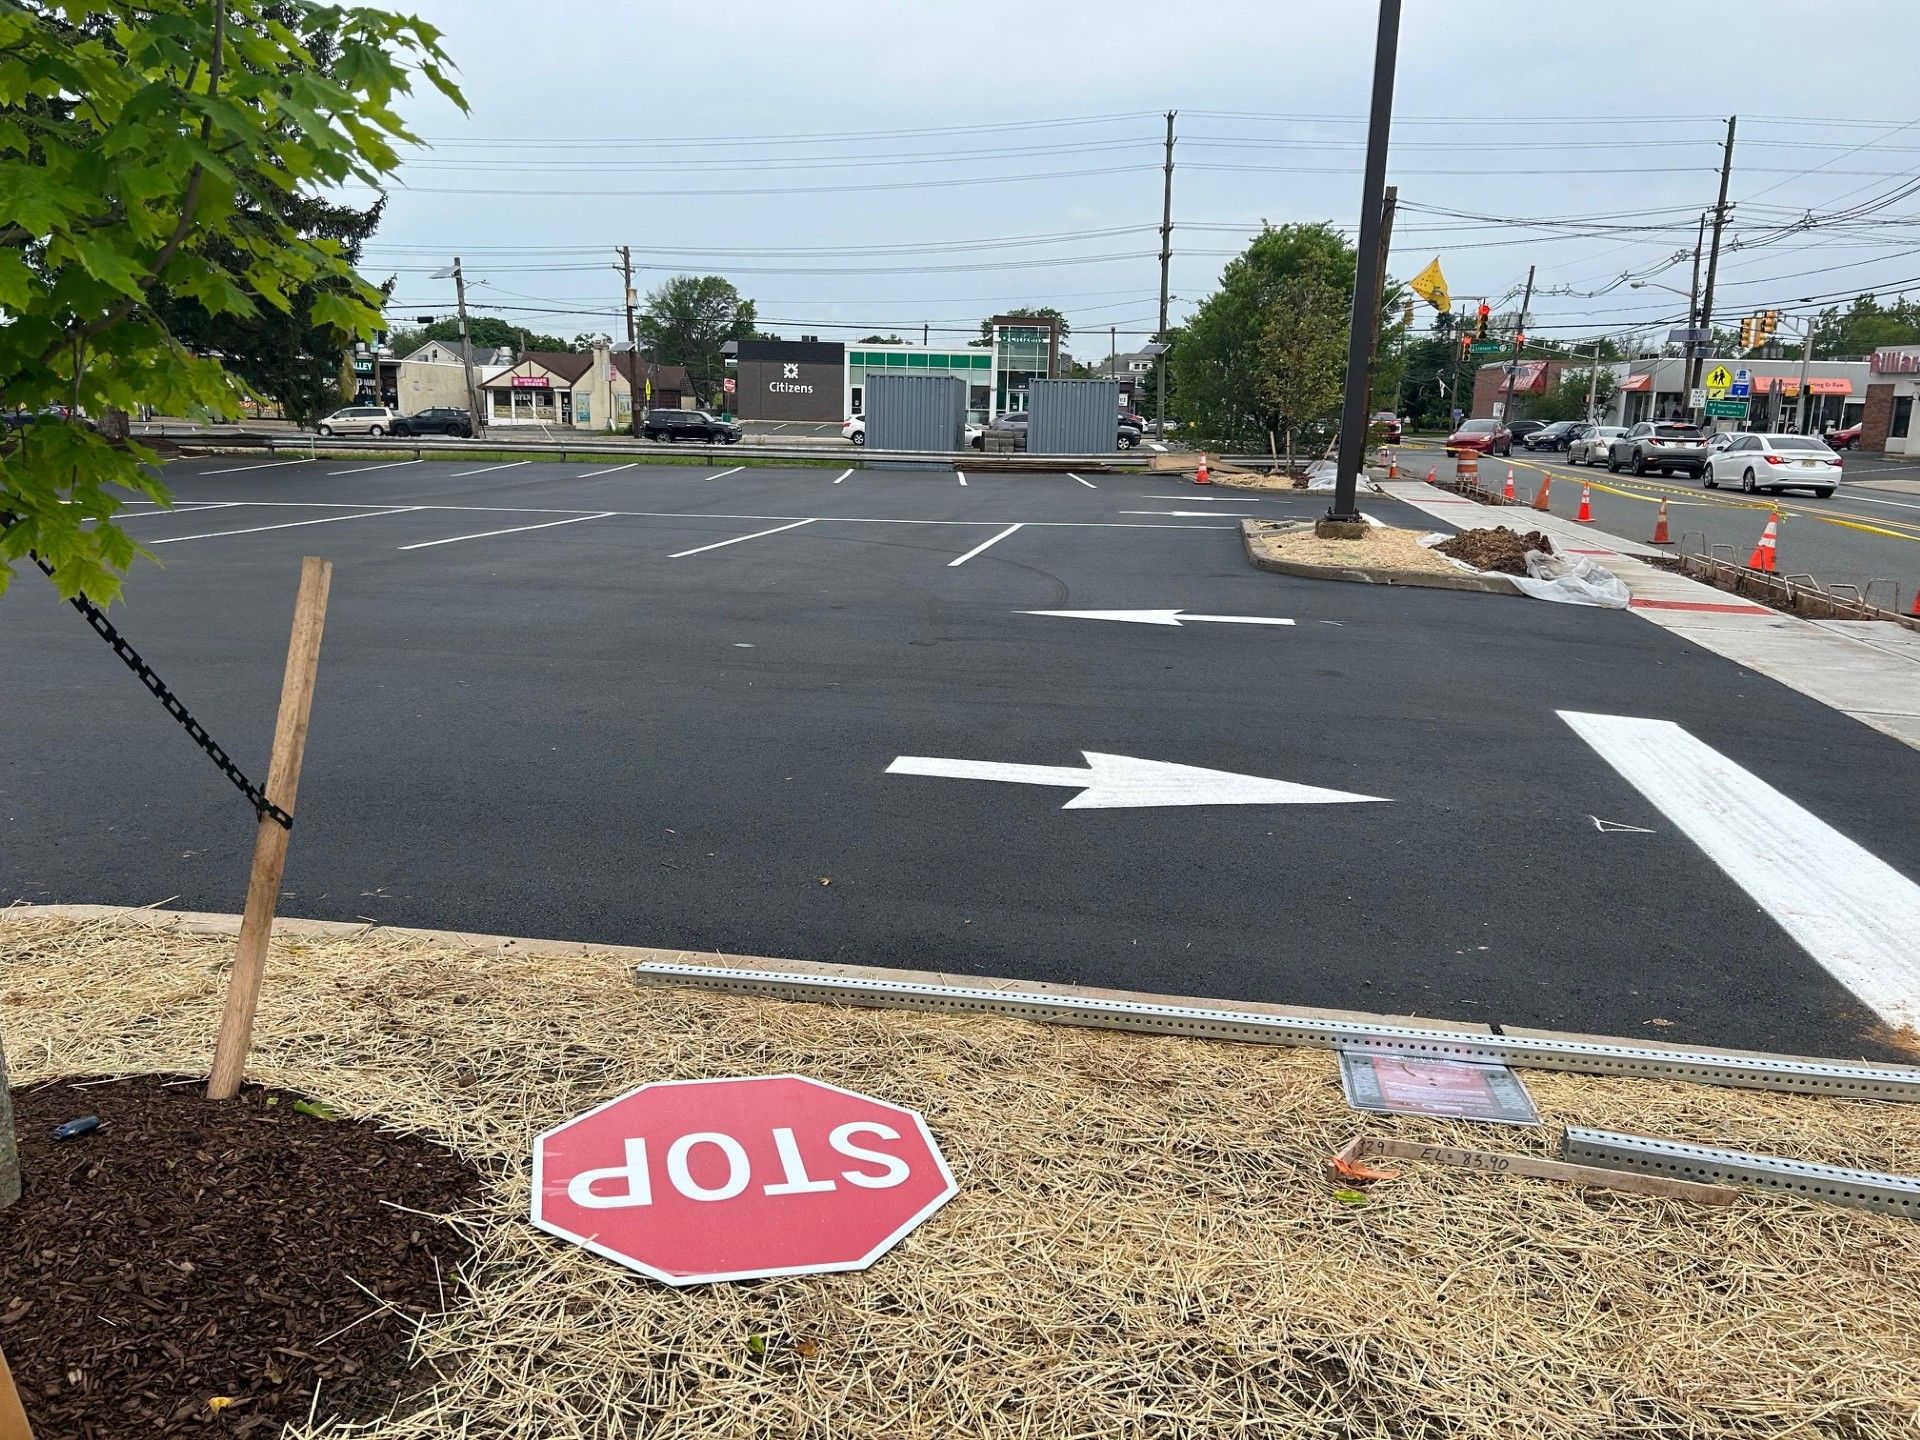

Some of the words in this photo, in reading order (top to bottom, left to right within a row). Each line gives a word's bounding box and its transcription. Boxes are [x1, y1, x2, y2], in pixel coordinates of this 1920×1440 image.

[769, 381, 814, 394] Citizens
[567, 1121, 911, 1209] STOP
[1462, 1153, 1509, 1171] 83.90
